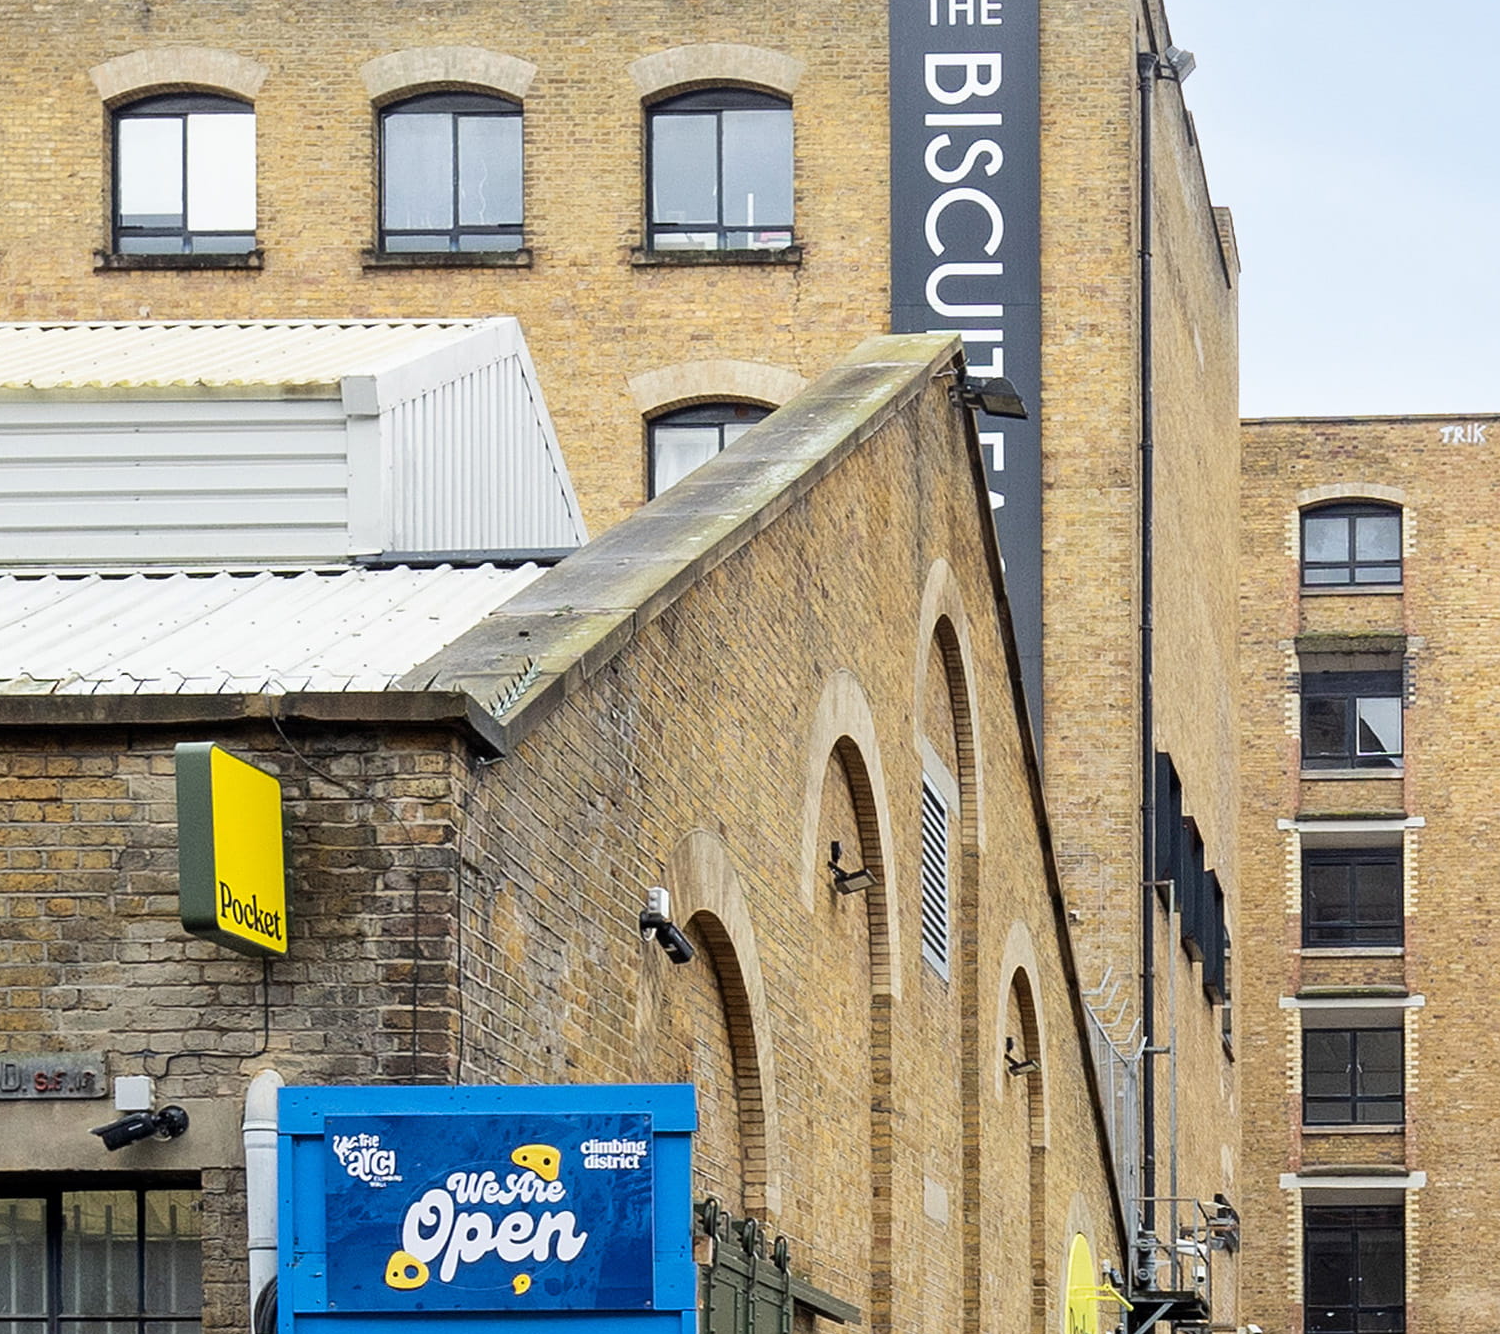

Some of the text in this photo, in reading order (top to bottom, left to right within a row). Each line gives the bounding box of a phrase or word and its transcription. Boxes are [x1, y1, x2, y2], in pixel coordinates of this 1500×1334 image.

[1440, 422, 1487, 444] TRIK
[218, 880, 282, 941] Pocket
[580, 1139, 647, 1157] climbing
[583, 1153, 641, 1170] district
[446, 1171, 566, 1205] We Are
[402, 1188, 588, 1283] Open
